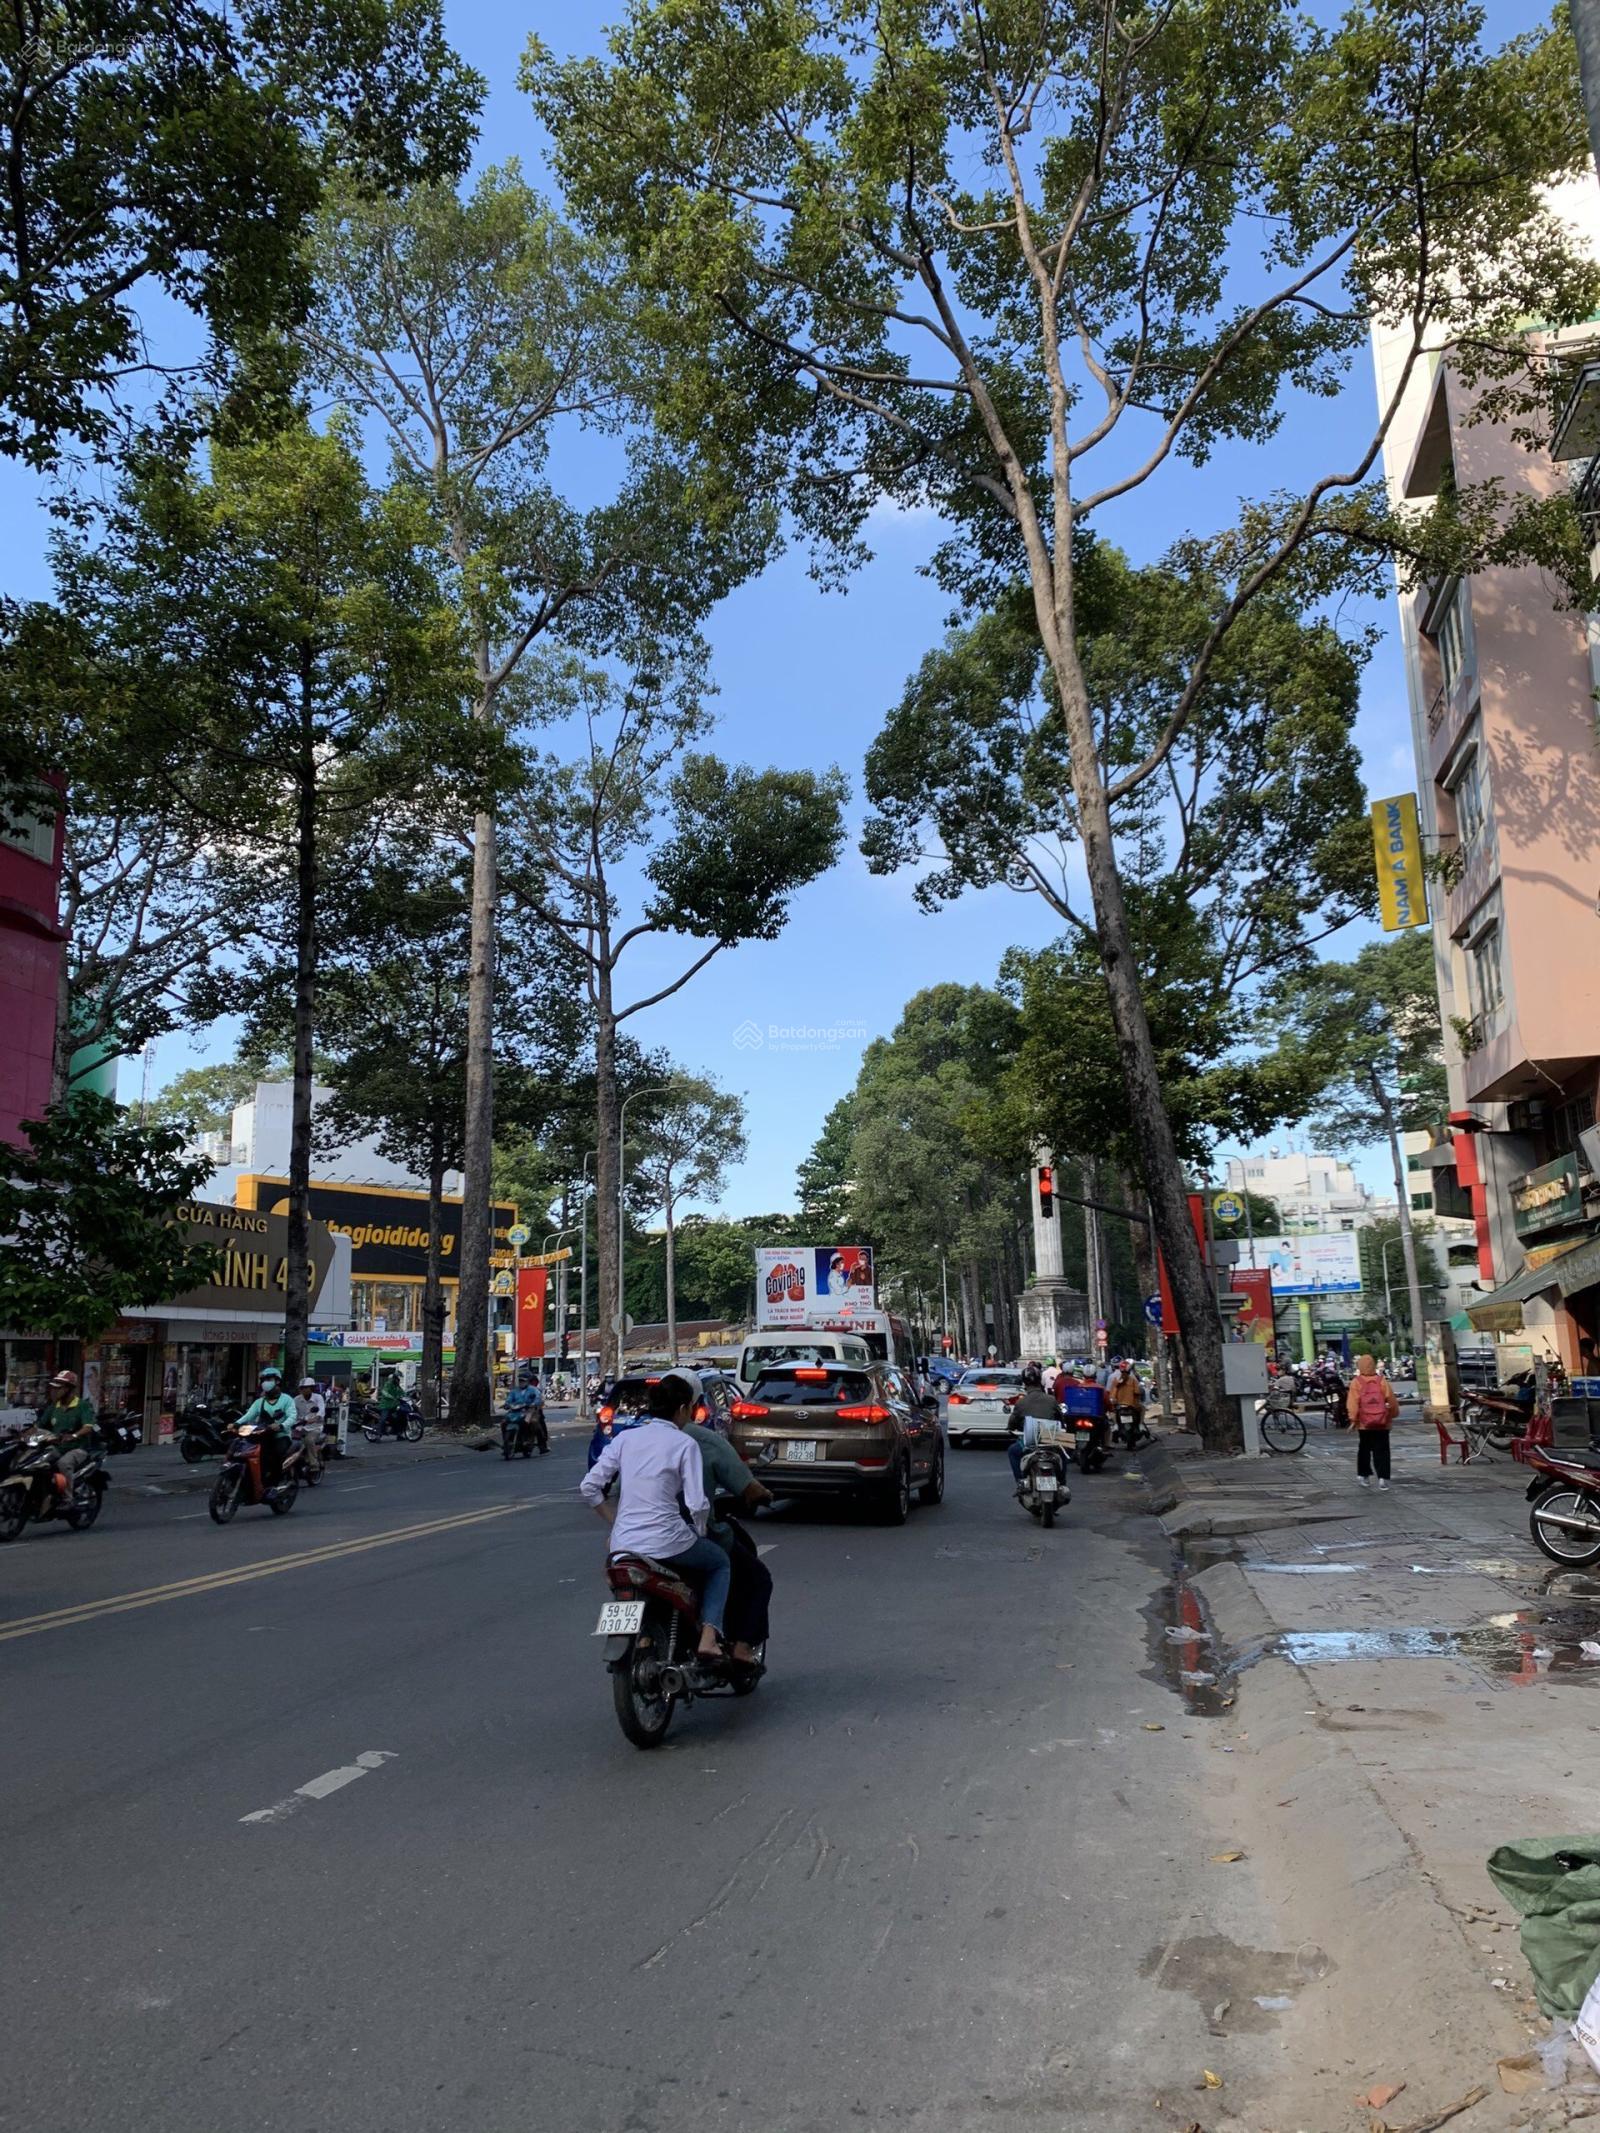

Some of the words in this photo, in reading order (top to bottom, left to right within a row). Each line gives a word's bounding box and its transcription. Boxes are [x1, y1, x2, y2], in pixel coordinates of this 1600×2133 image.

[1386, 800, 1404, 854] BANK
[1392, 858, 1407, 873] A
[1394, 878, 1410, 926] NAM
[176, 1201, 215, 1226] CỬA
[220, 1208, 268, 1233] HÀNG
[276, 1256, 317, 1293] 49
[766, 1267, 805, 1296] Covid-19
[600, 1618, 639, 1632] 030.73
[607, 1604, 638, 1618] 59-U2
